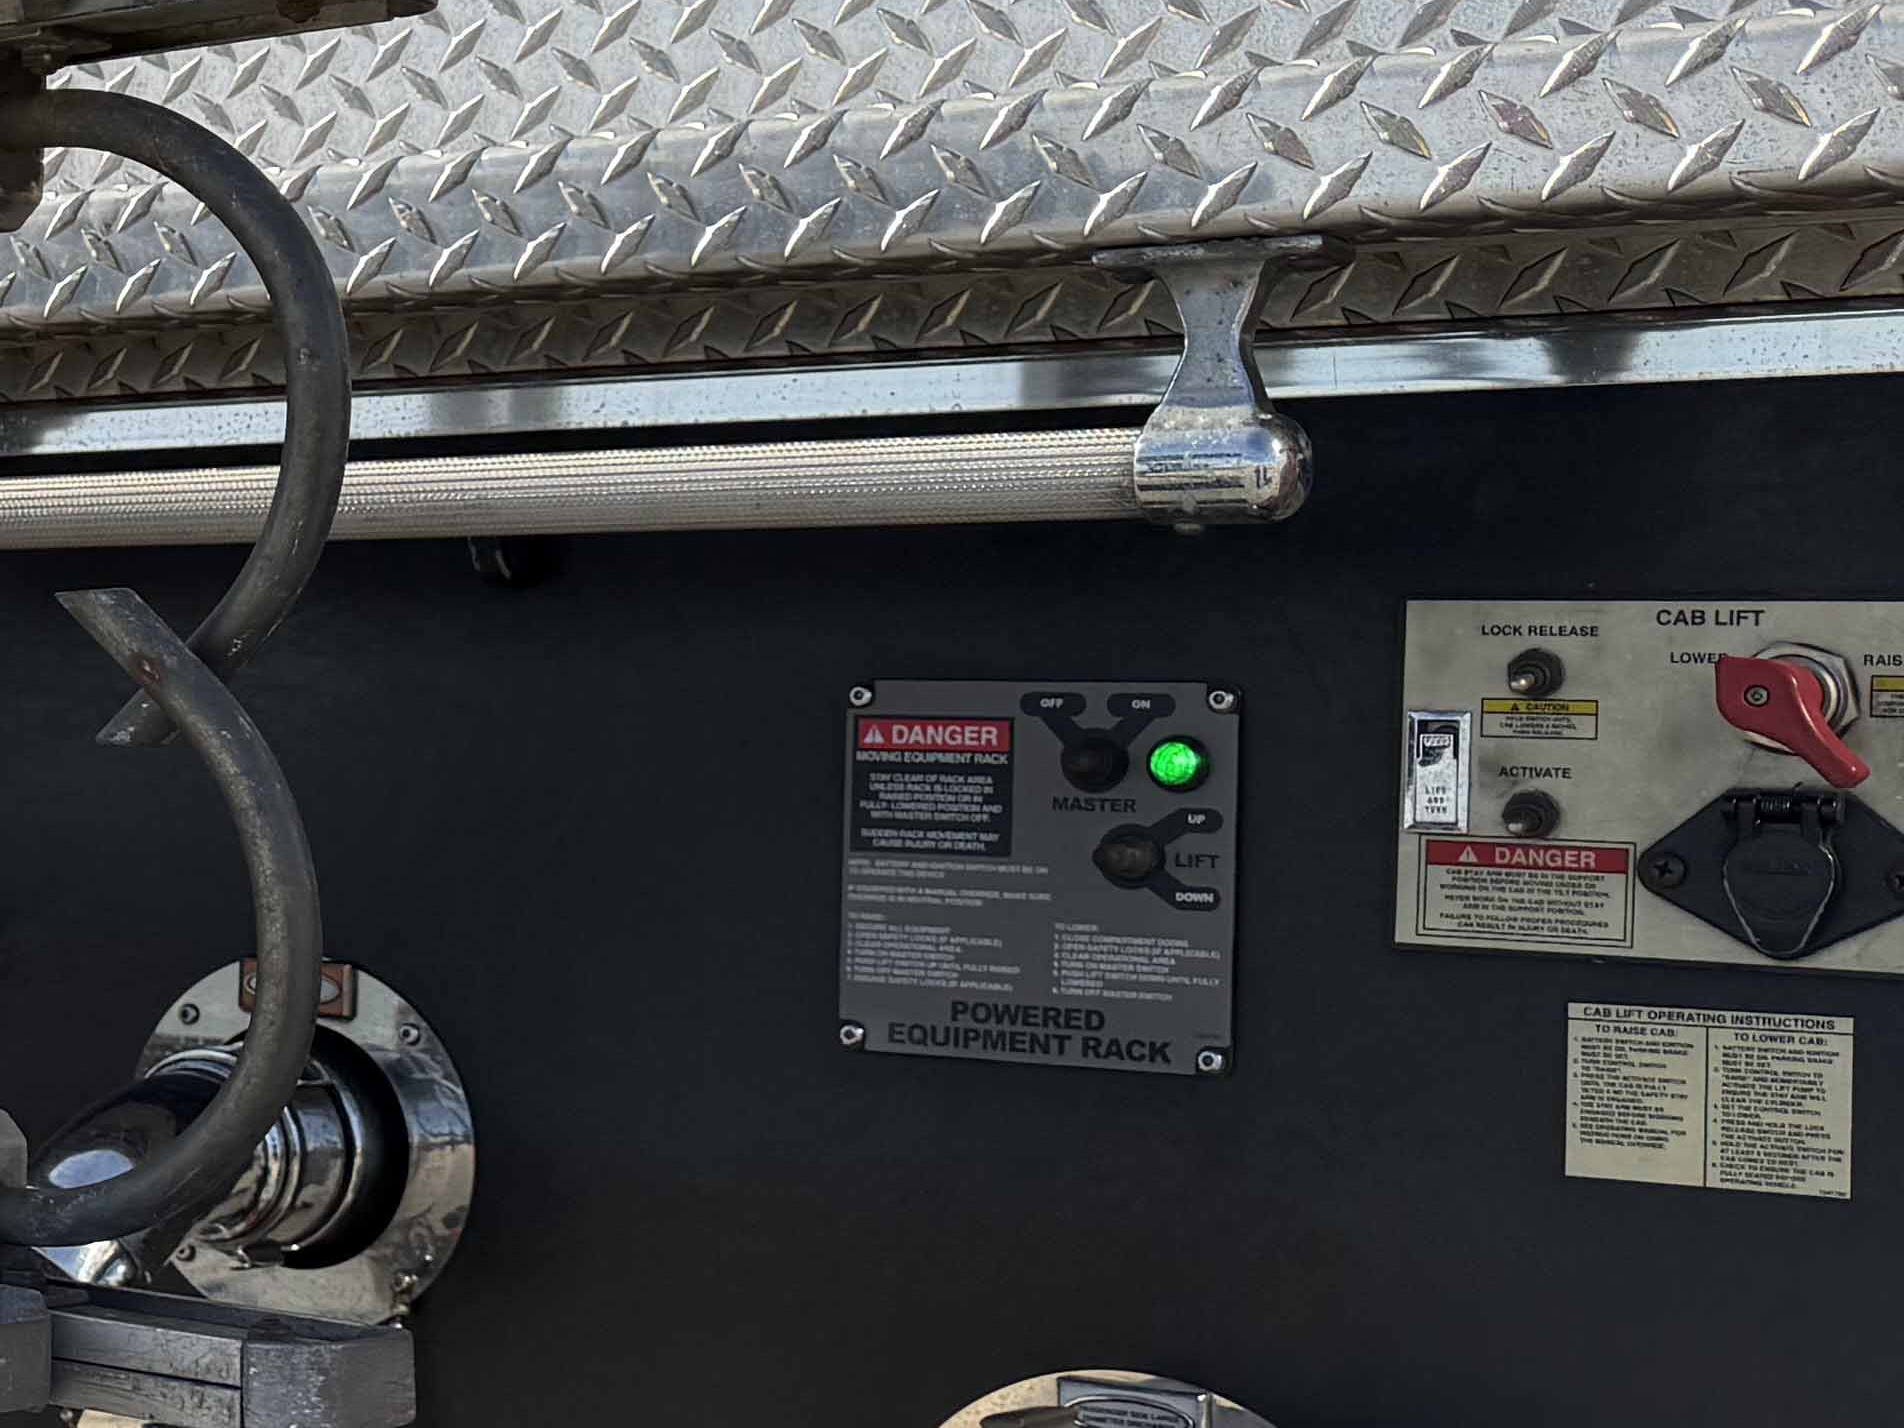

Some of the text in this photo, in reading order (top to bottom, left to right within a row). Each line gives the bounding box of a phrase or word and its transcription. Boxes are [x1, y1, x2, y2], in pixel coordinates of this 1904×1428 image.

[1656, 609, 1765, 627] CAB LIFT
[1481, 624, 1599, 637] LOCK RELEASE
[1670, 652, 1728, 664] LOWE
[1863, 654, 1903, 667] RAIS
[1039, 698, 1064, 709] OFF
[1131, 699, 1151, 709] ON
[1525, 702, 1569, 712] CAUTION
[892, 725, 998, 746] DANGER
[856, 751, 1009, 765] MOVING EQUIPMENT RACK
[1498, 766, 1572, 779] ACTIVATE
[1051, 795, 1137, 813] MASTER
[1187, 813, 1207, 824] UP
[1174, 853, 1220, 869] LIFT
[1494, 847, 1596, 868] DANGER
[1175, 892, 1215, 903] DOWN
[949, 1000, 1106, 1031] POWERED
[1583, 1006, 1836, 1031] CAB LIFT OPERATING INSTRUCTIONS
[1595, 1024, 1611, 1034] TO
[1613, 1025, 1648, 1036] RAISE
[887, 1022, 1172, 1065] EQUIPMENT RACK
[1734, 1032, 1829, 1046] TO LOWER CAB:
